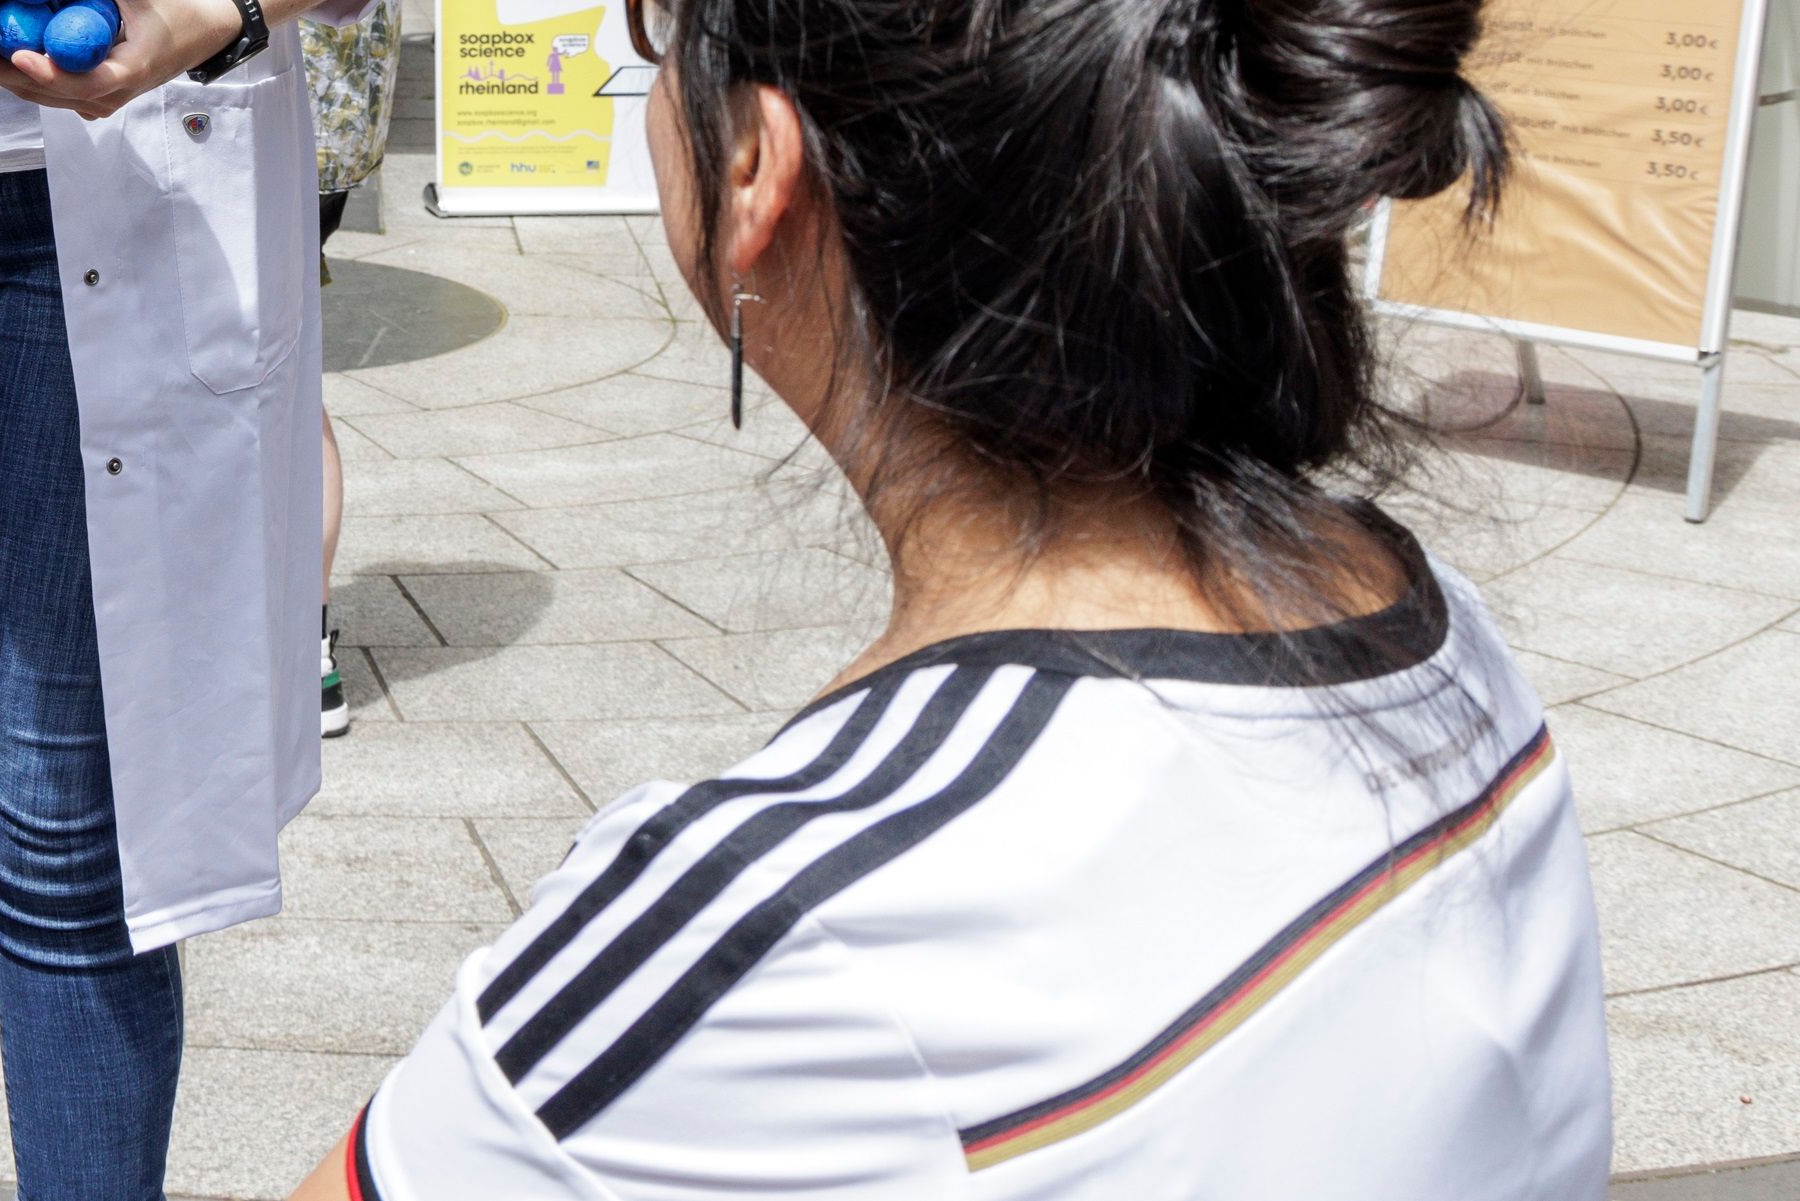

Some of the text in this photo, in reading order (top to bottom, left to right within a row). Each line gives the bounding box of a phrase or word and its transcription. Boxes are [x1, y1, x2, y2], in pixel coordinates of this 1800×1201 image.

[459, 31, 535, 47] soapbox
[459, 44, 525, 58] science
[459, 81, 539, 95] rheinland
[511, 162, 536, 173] hhu
